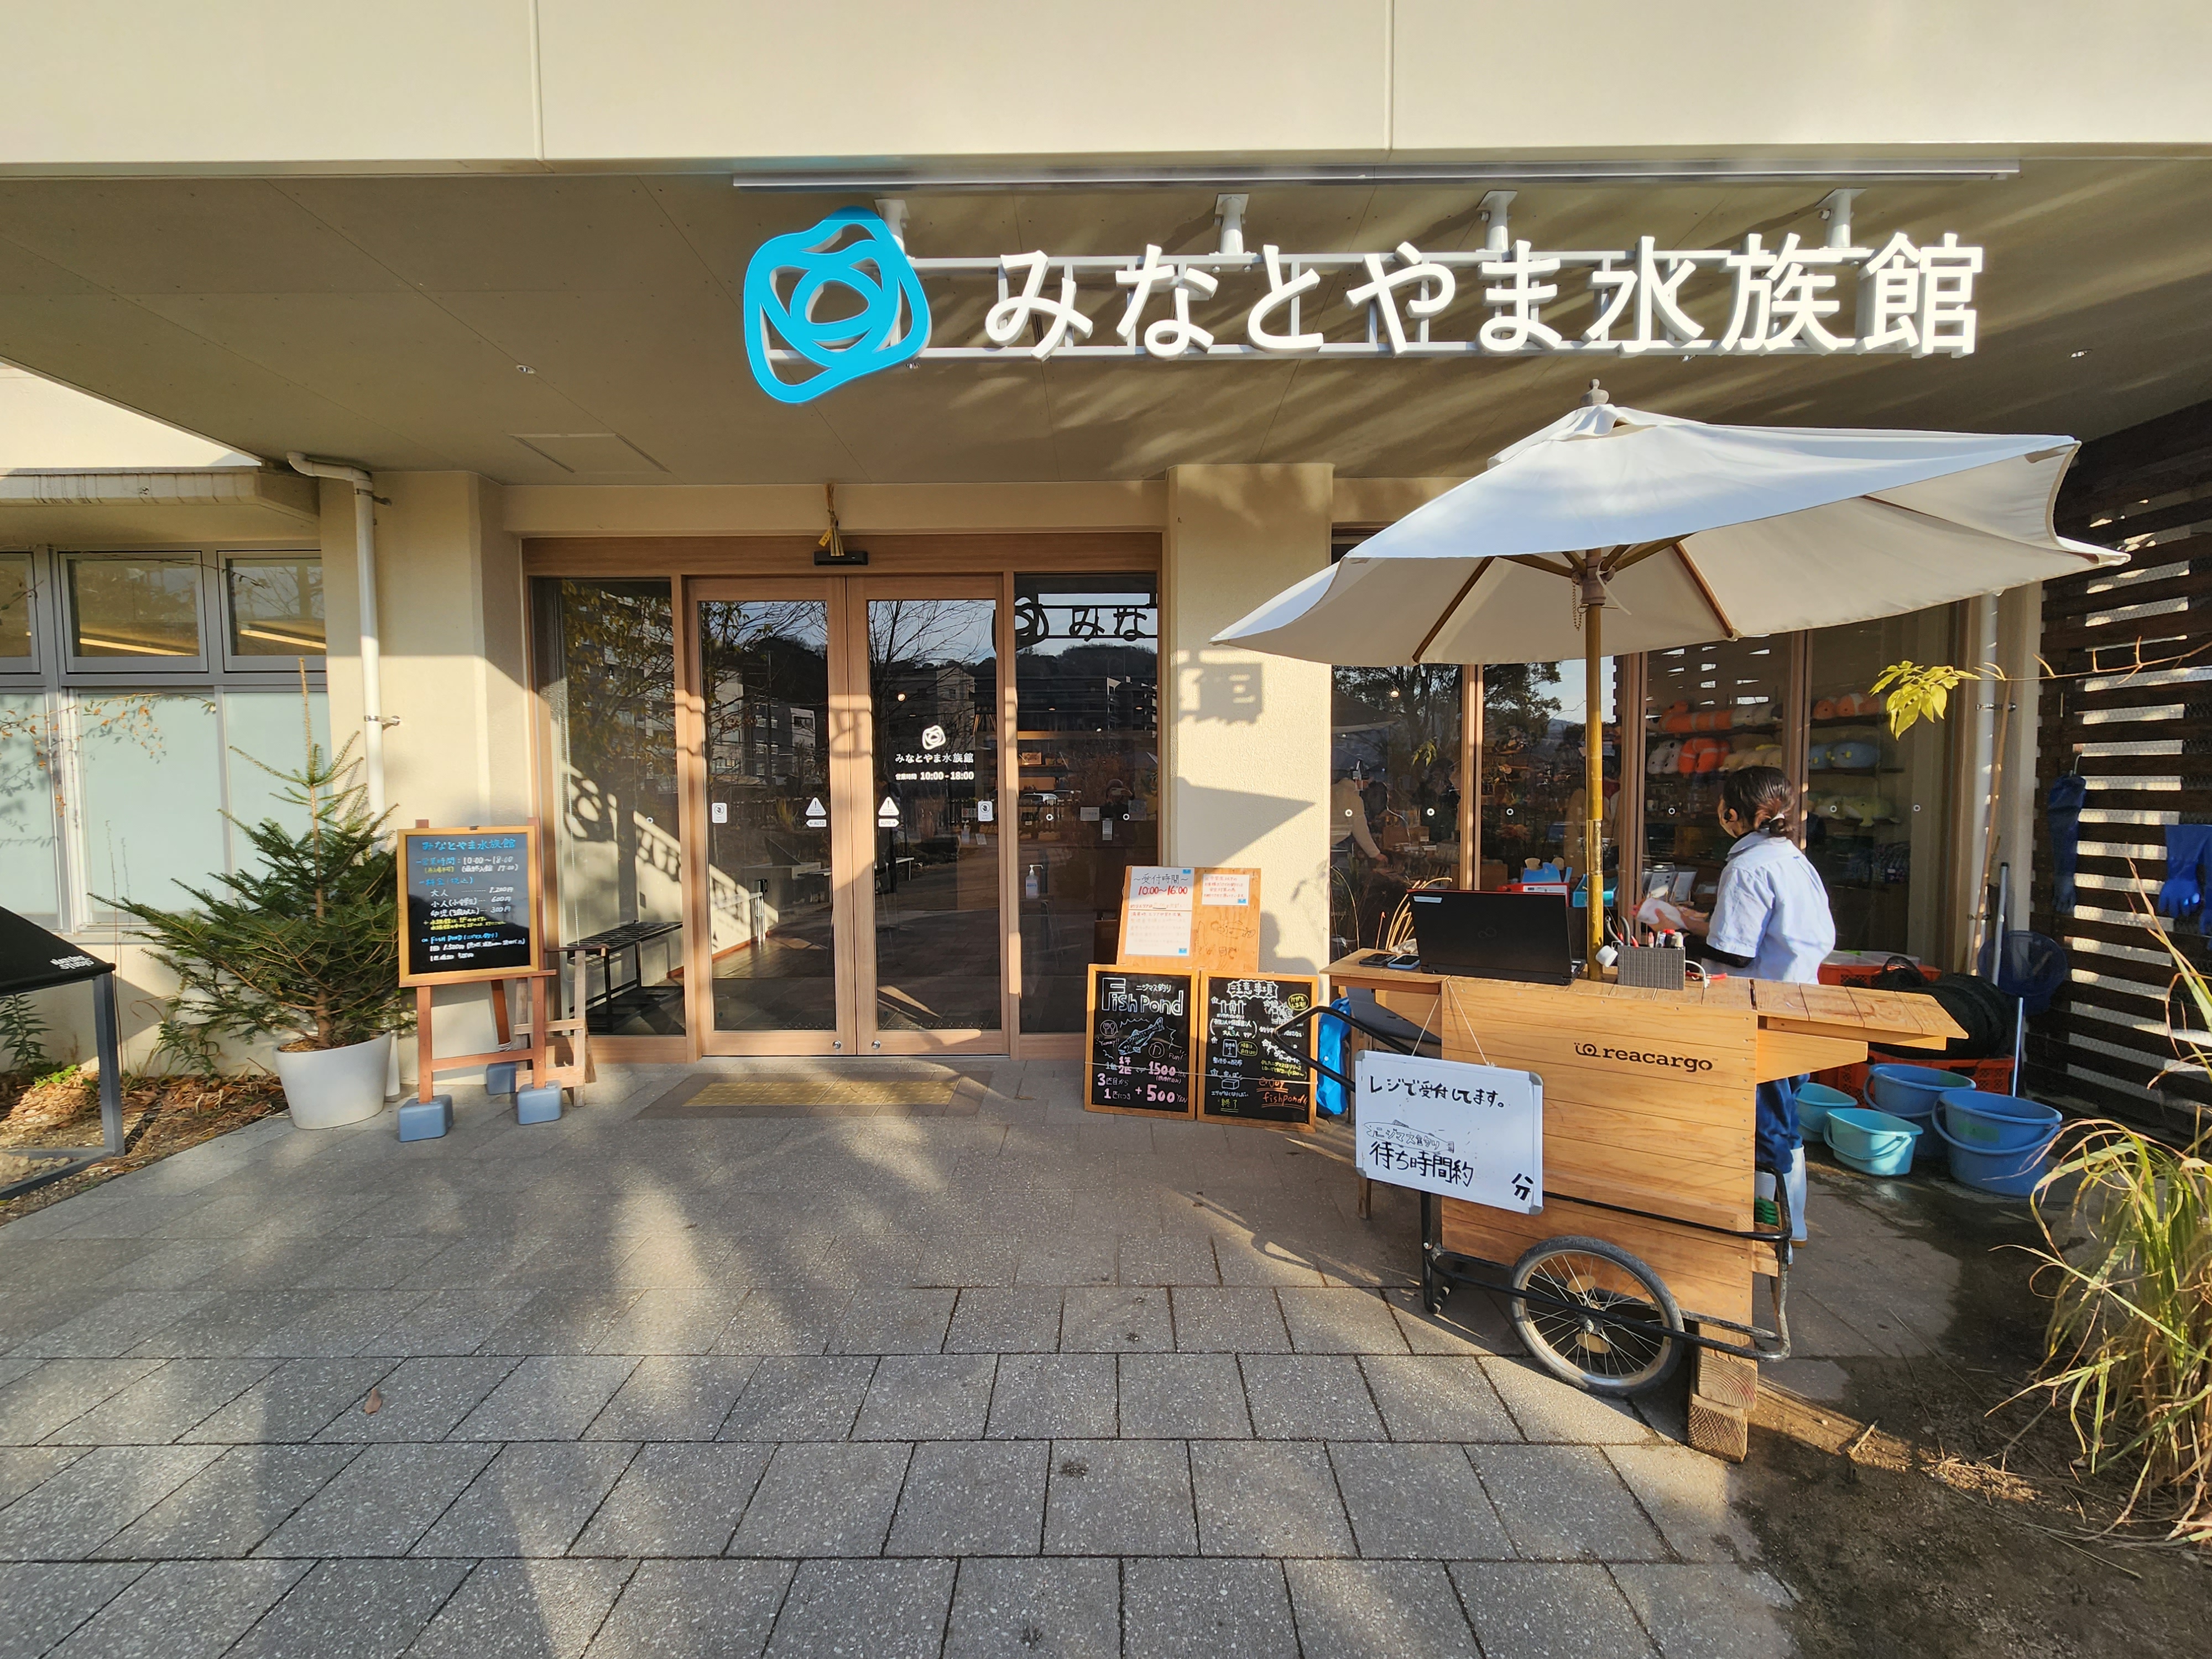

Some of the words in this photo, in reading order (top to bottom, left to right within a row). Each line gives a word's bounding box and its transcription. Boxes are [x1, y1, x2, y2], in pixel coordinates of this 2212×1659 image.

[984, 232, 1984, 359] みなとやま水族館
[895, 753, 974, 763] みなとやま水族館
[920, 771, 944, 780] 10:00
[950, 771, 974, 780] 18:00
[421, 838, 516, 851] みなとやま水族館
[430, 889, 449, 897] 大人
[59, 959, 95, 969] STUDIO
[1135, 983, 1172, 993] ニジマス釣り
[1230, 981, 1274, 996] 注意事項
[1101, 977, 1137, 1013] Fish
[1139, 989, 1184, 1016] Pond
[1602, 1047, 1713, 1073] reacargo
[1148, 1061, 1176, 1077] 1500
[1097, 1072, 1129, 1087] 3匹目から
[1259, 1076, 1285, 1089] enjoy
[1146, 1083, 1176, 1103] 500
[1176, 1093, 1188, 1104] YEN
[1369, 1075, 1505, 1108] レジで受付してます。
[1369, 1140, 1474, 1188] 待ち時間約
[1511, 1172, 1534, 1201] 分
